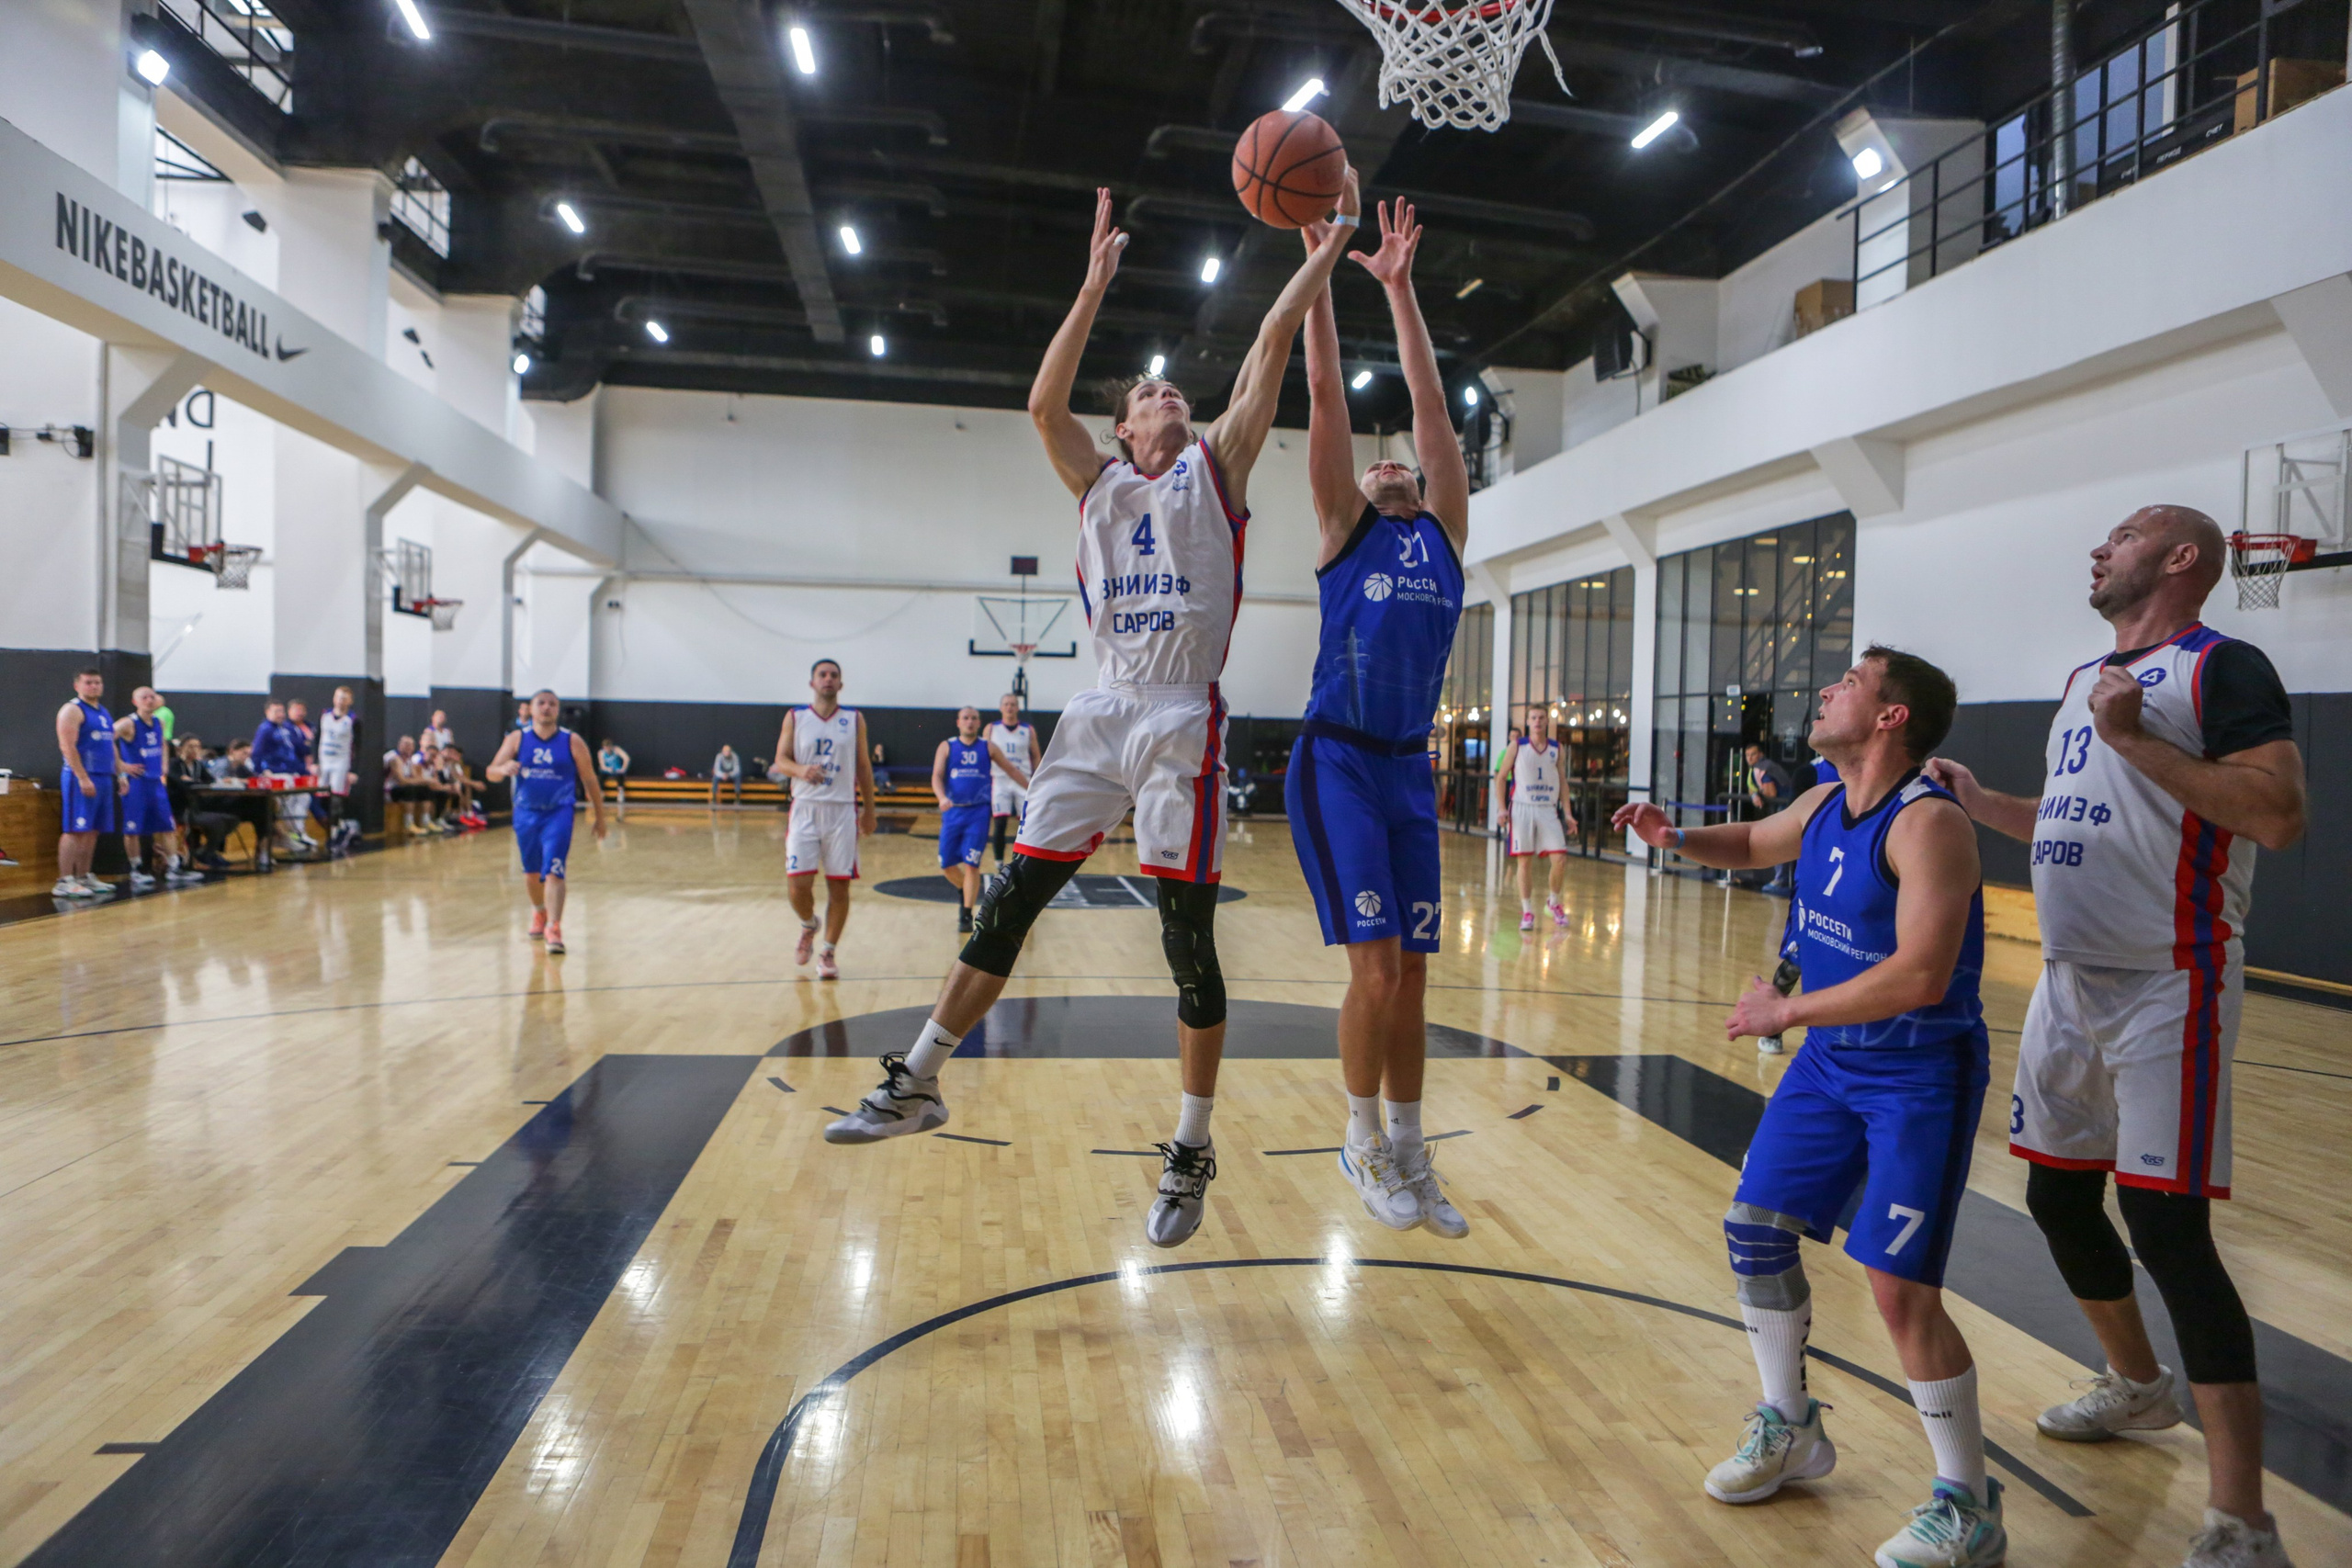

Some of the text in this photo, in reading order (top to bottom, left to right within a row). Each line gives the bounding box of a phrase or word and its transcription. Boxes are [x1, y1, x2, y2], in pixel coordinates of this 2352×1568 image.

[56, 191, 270, 359] NIKEBASKETBALL
[1132, 513, 1155, 556] 4
[1102, 574, 1191, 599] ВНИИЭФ
[1114, 611, 1174, 633] САРОВ
[533, 748, 553, 764] 24
[815, 739, 833, 756] 12
[961, 751, 978, 764] 30
[1007, 742, 1015, 753] 11
[2054, 726, 2092, 777] 13
[1537, 767, 1543, 780] 1
[966, 849, 981, 863] 30
[1823, 846, 1845, 897] 7
[1357, 918, 1386, 928] РОССЕТИ
[1808, 909, 1852, 942] РОССЕТИ
[1807, 928, 1850, 955] МОСКОВСКИЙ
[1885, 1202, 1925, 1257] 7
